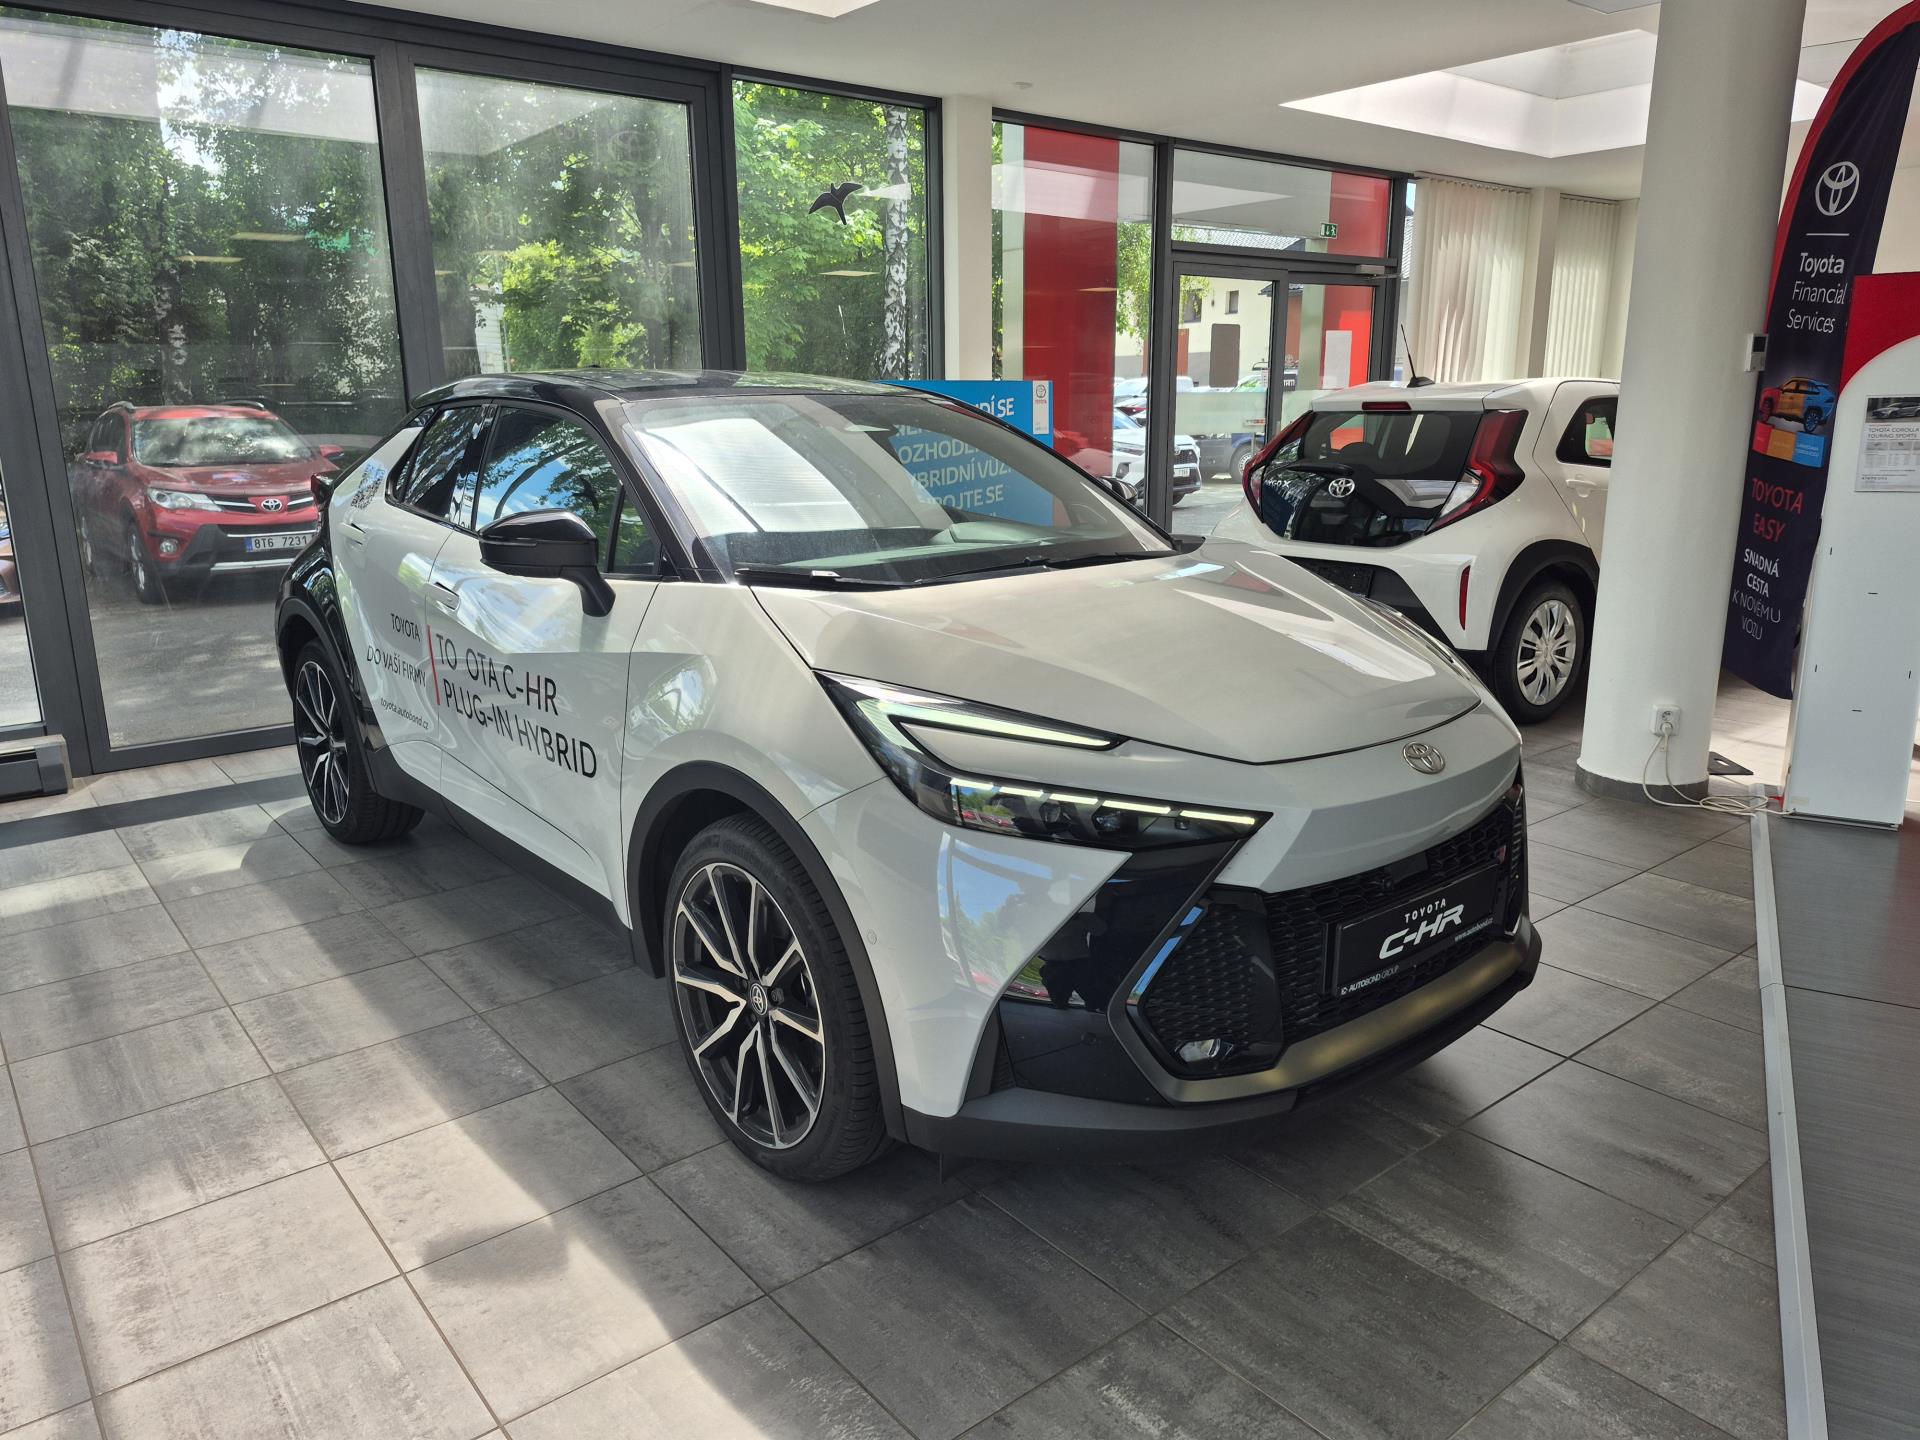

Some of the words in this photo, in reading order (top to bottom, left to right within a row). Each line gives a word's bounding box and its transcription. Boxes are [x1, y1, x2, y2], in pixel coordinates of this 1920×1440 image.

[1799, 252, 1845, 278] Toyota
[1792, 280, 1848, 305] Financial
[1787, 308, 1836, 333] Services
[998, 397, 1015, 418] SE
[985, 484, 1004, 504] SE
[1751, 478, 1803, 514] TOYOTA
[1753, 513, 1786, 543] EASY
[254, 535, 274, 549] 8T6
[281, 534, 308, 547] 7231
[1744, 548, 1779, 578] SNADNÁ
[1746, 572, 1769, 598] CESTA
[1732, 589, 1738, 603] K
[1739, 593, 1781, 623] NOVÉMU
[391, 612, 421, 642] TOYOTA
[1741, 615, 1763, 641] VOZU
[366, 644, 381, 665] DO
[383, 651, 401, 674] VAŠÍ
[402, 664, 426, 688] FIRMY
[502, 664, 559, 716] C-HR
[443, 678, 514, 742] PLUG-IN
[514, 714, 598, 778] HYBRID
[1404, 898, 1447, 924] TOYOTA
[1379, 904, 1465, 960] C-HR
[1348, 973, 1382, 993] AUTOBOND
